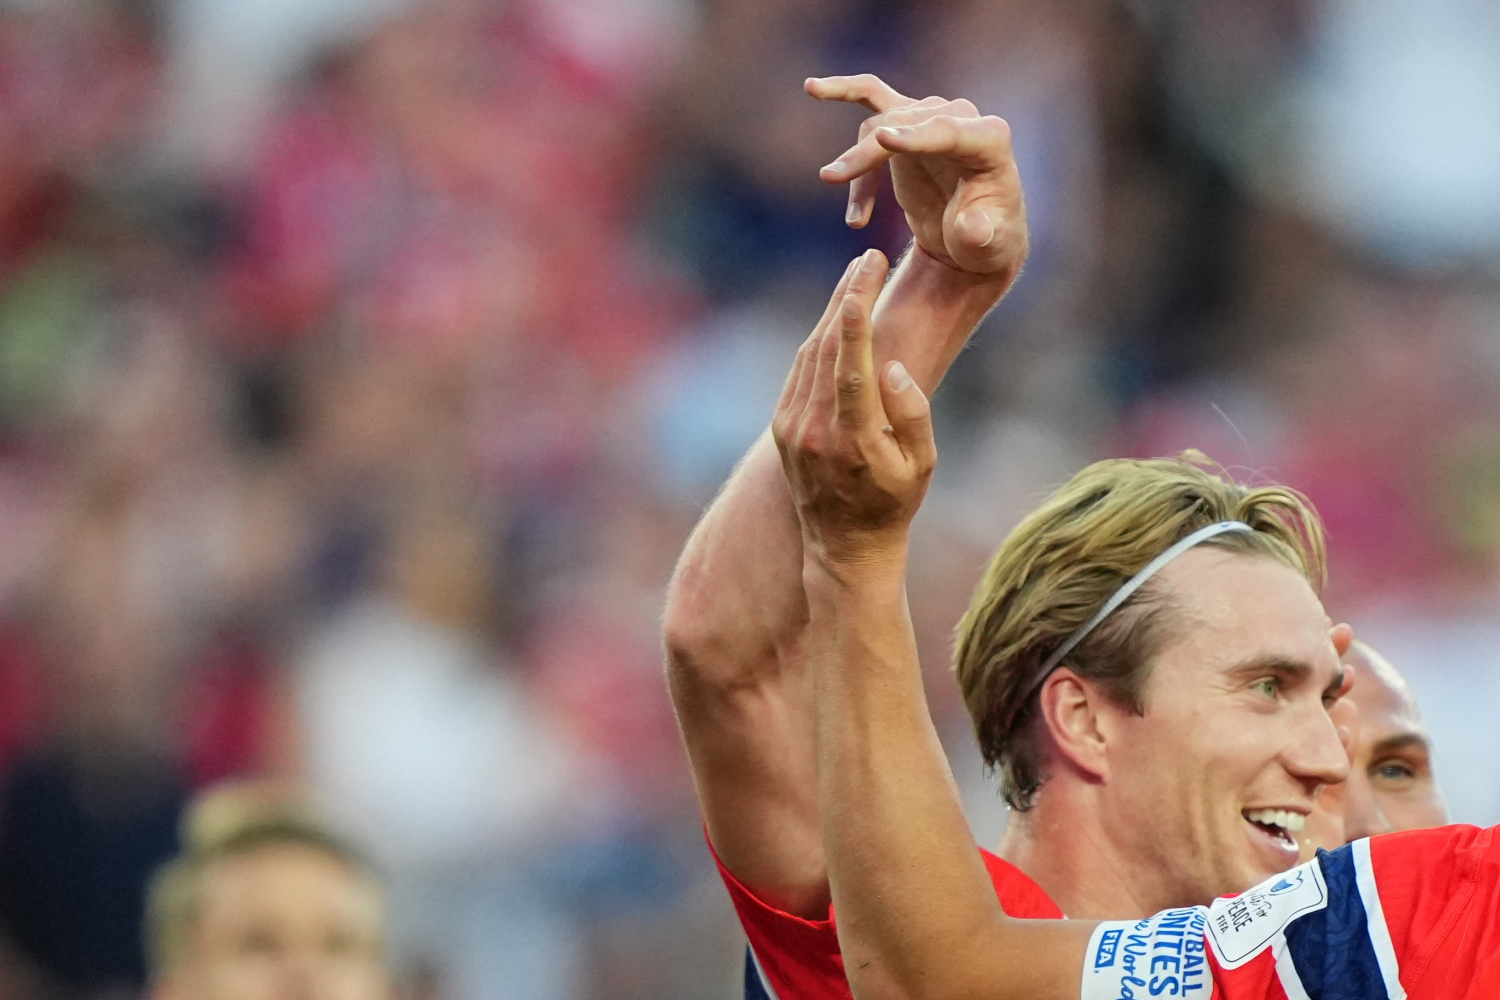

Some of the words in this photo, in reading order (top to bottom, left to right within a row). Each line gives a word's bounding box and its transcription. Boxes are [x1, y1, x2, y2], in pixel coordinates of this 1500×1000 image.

[1215, 914, 1230, 935] FIFA
[1224, 897, 1253, 933] PEACE
[1098, 930, 1119, 965] FIFA
[1149, 907, 1198, 997] UNITES
